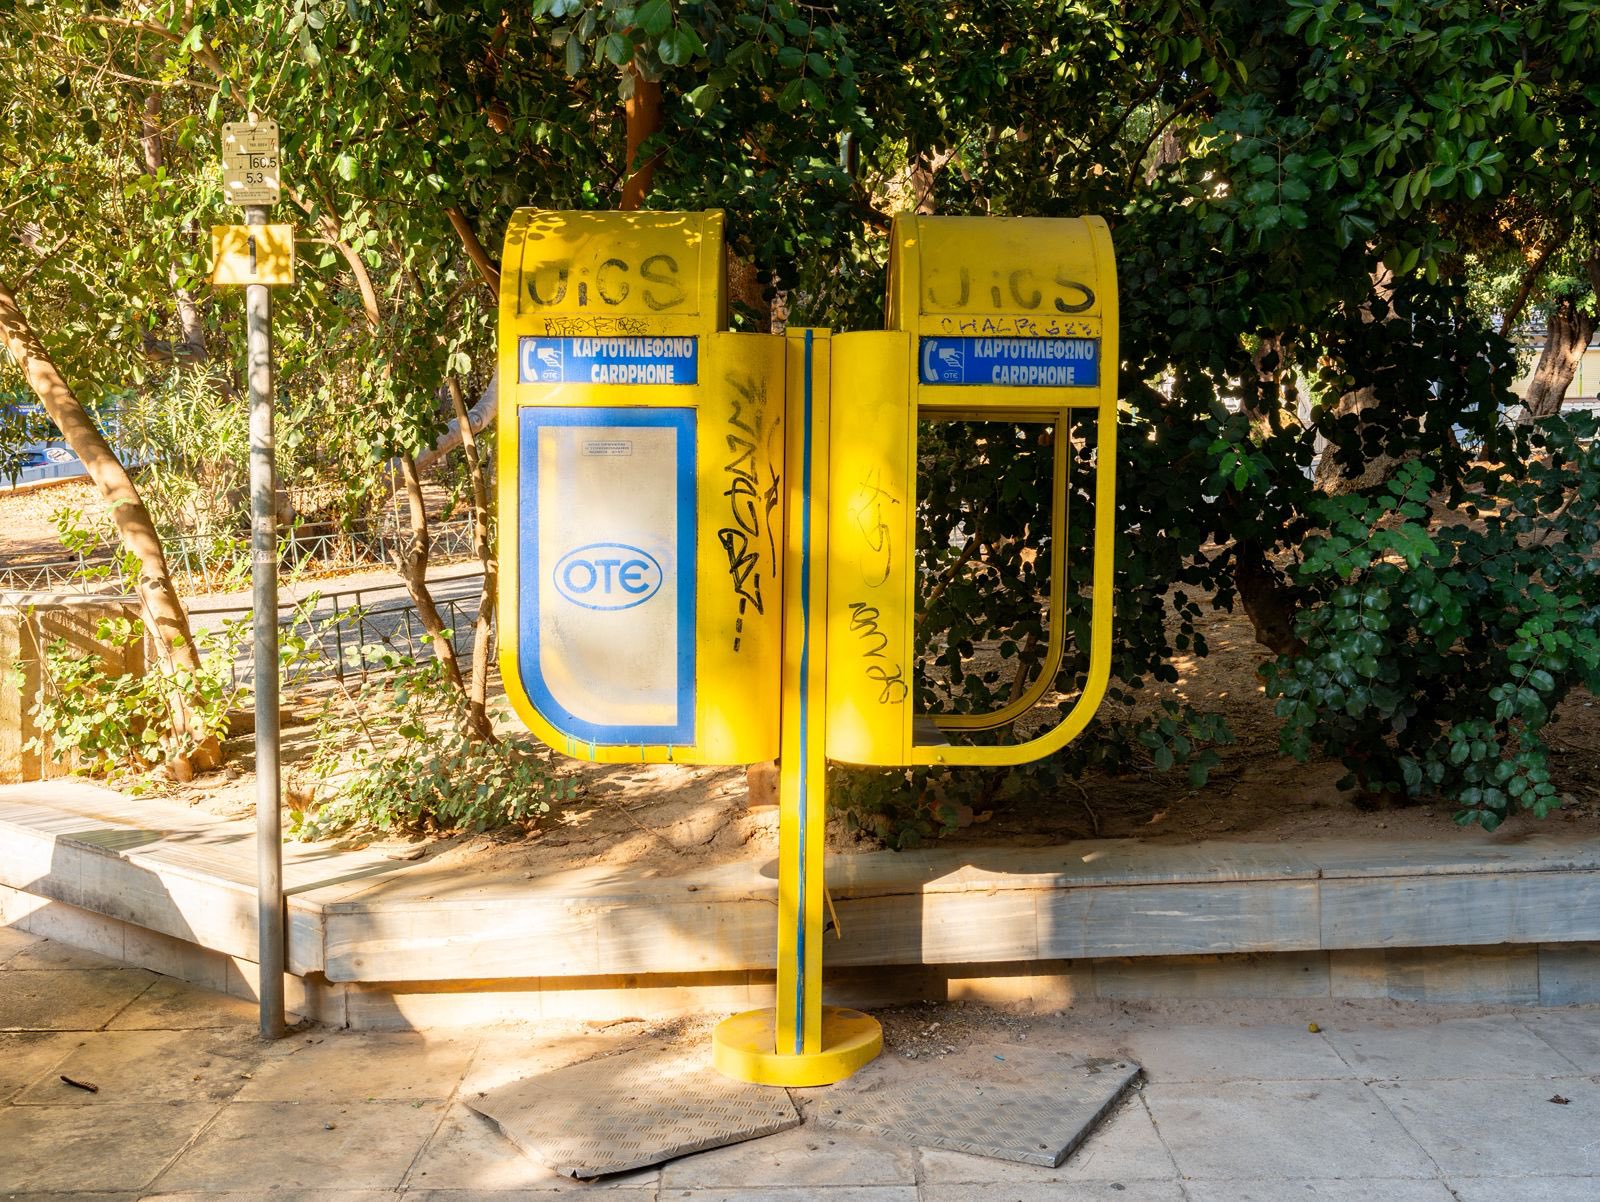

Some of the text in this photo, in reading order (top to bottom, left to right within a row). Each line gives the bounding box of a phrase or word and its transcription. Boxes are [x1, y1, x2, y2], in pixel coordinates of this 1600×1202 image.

[572, 338, 693, 359] ΚΑΡΤΟΤΗΛΕΦΩΝΟ
[974, 339, 1094, 360] ΚΑΡΤΟΤΗΛΕΦΩΝΟ
[591, 364, 674, 384] CARDPHONE
[991, 365, 1075, 385] CARDPHONE
